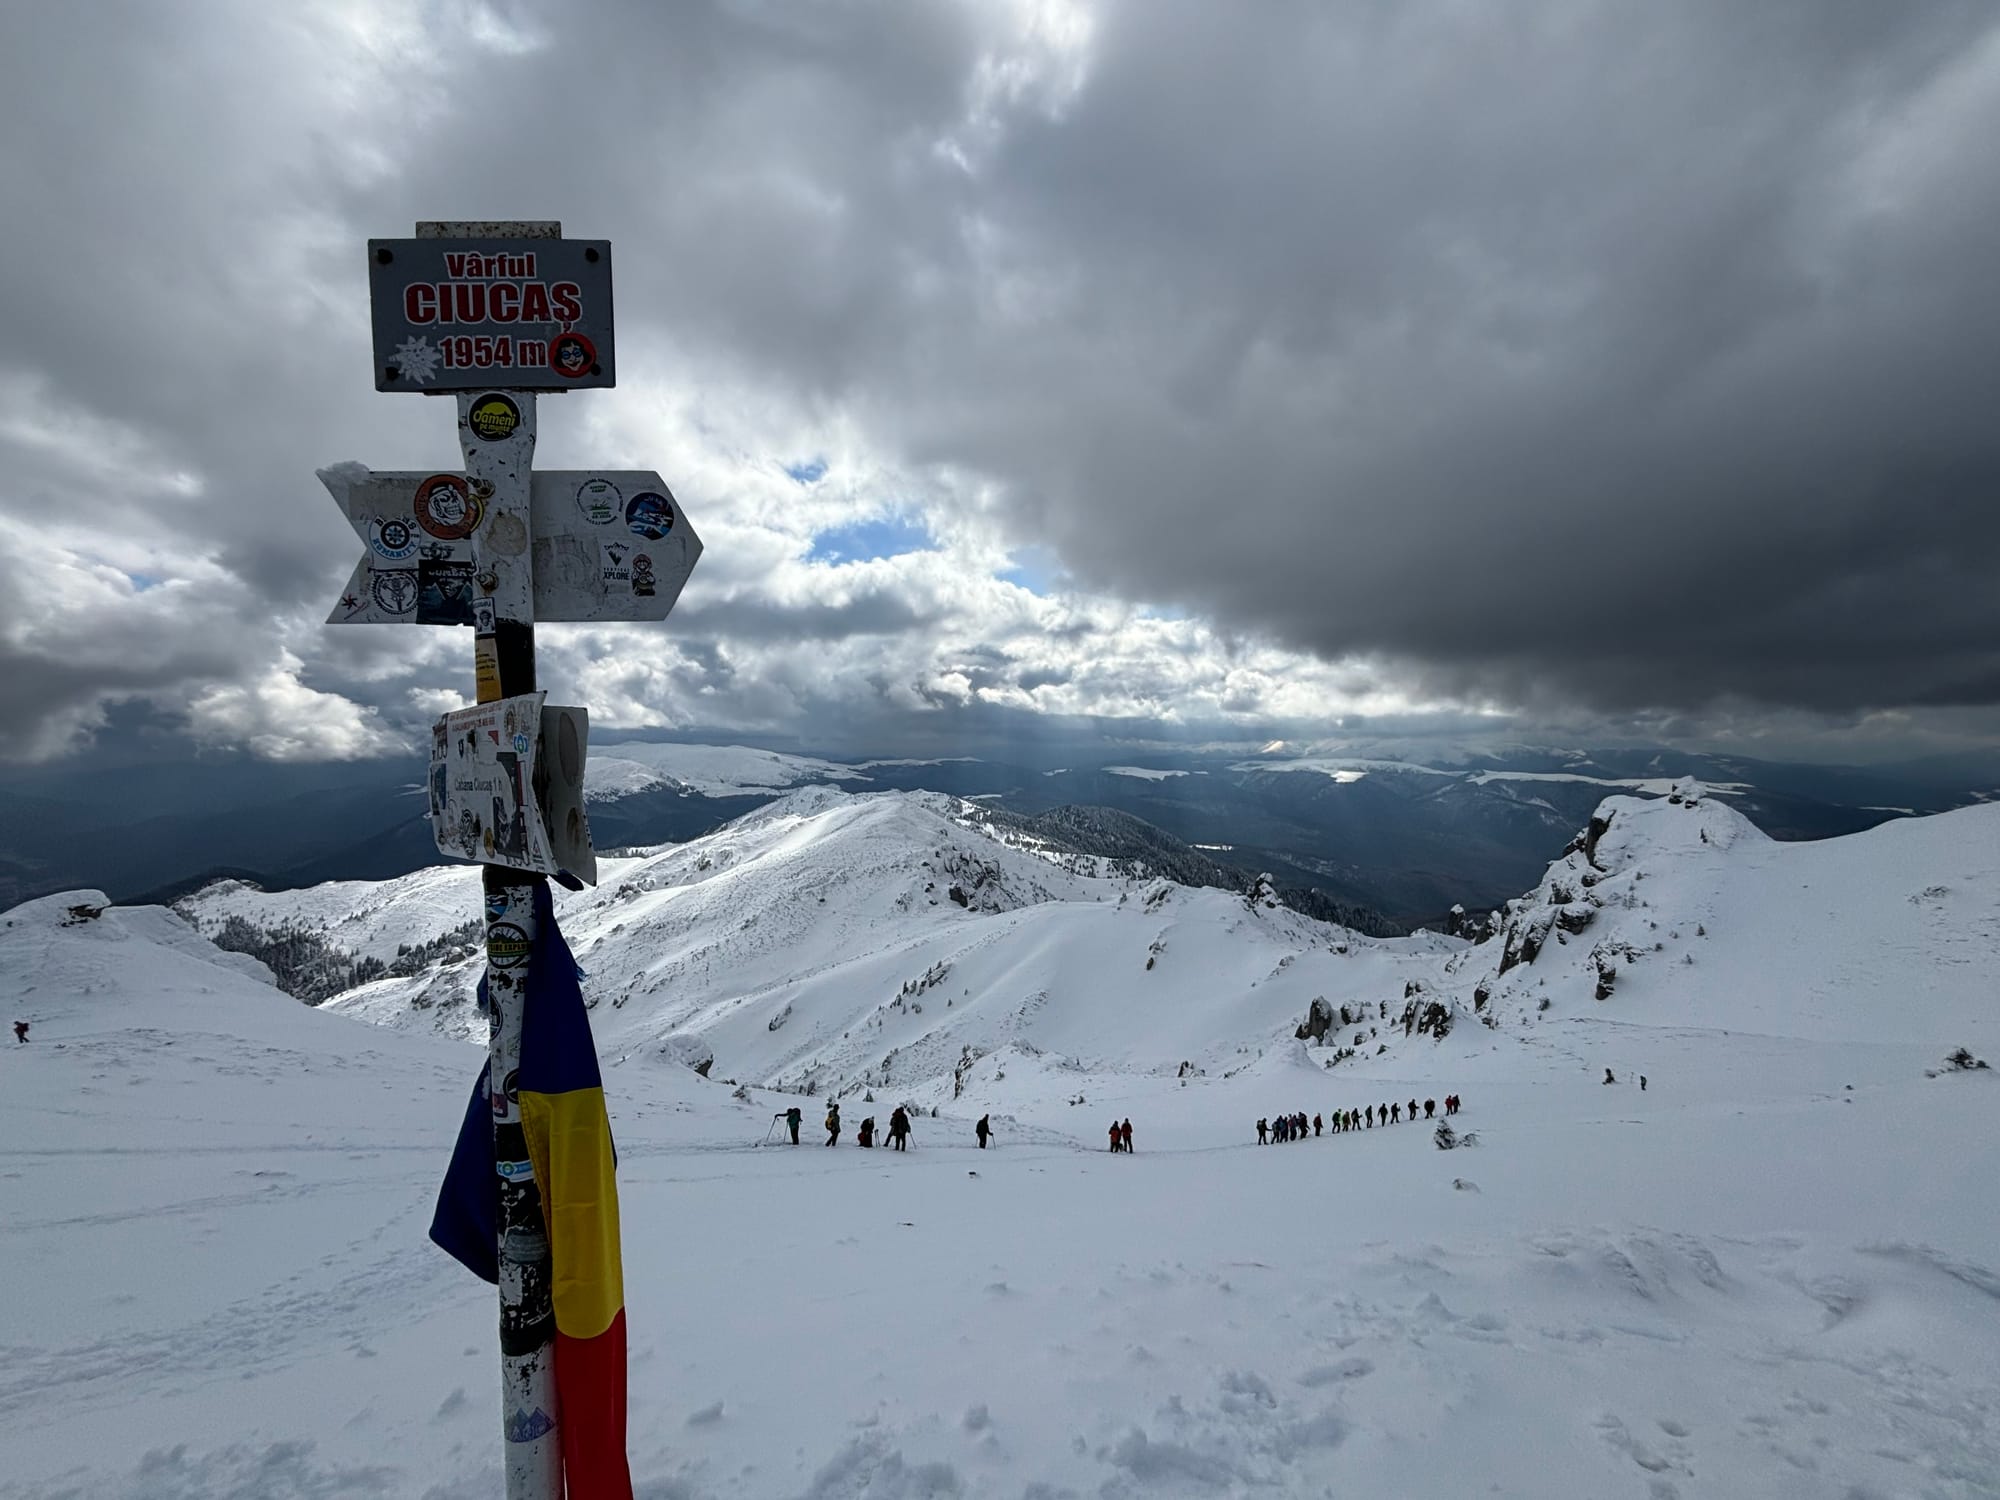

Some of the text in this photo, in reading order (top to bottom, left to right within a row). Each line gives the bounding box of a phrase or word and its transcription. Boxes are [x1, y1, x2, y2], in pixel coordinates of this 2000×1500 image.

[445, 251, 537, 279] Vârful
[404, 281, 582, 333] CIUCAȘ
[438, 336, 547, 369] 1954 m
[473, 409, 516, 427] Oameni
[373, 538, 416, 558] HUMANITY
[603, 572, 630, 580] XPLORE
[455, 778, 474, 791] Cabana
